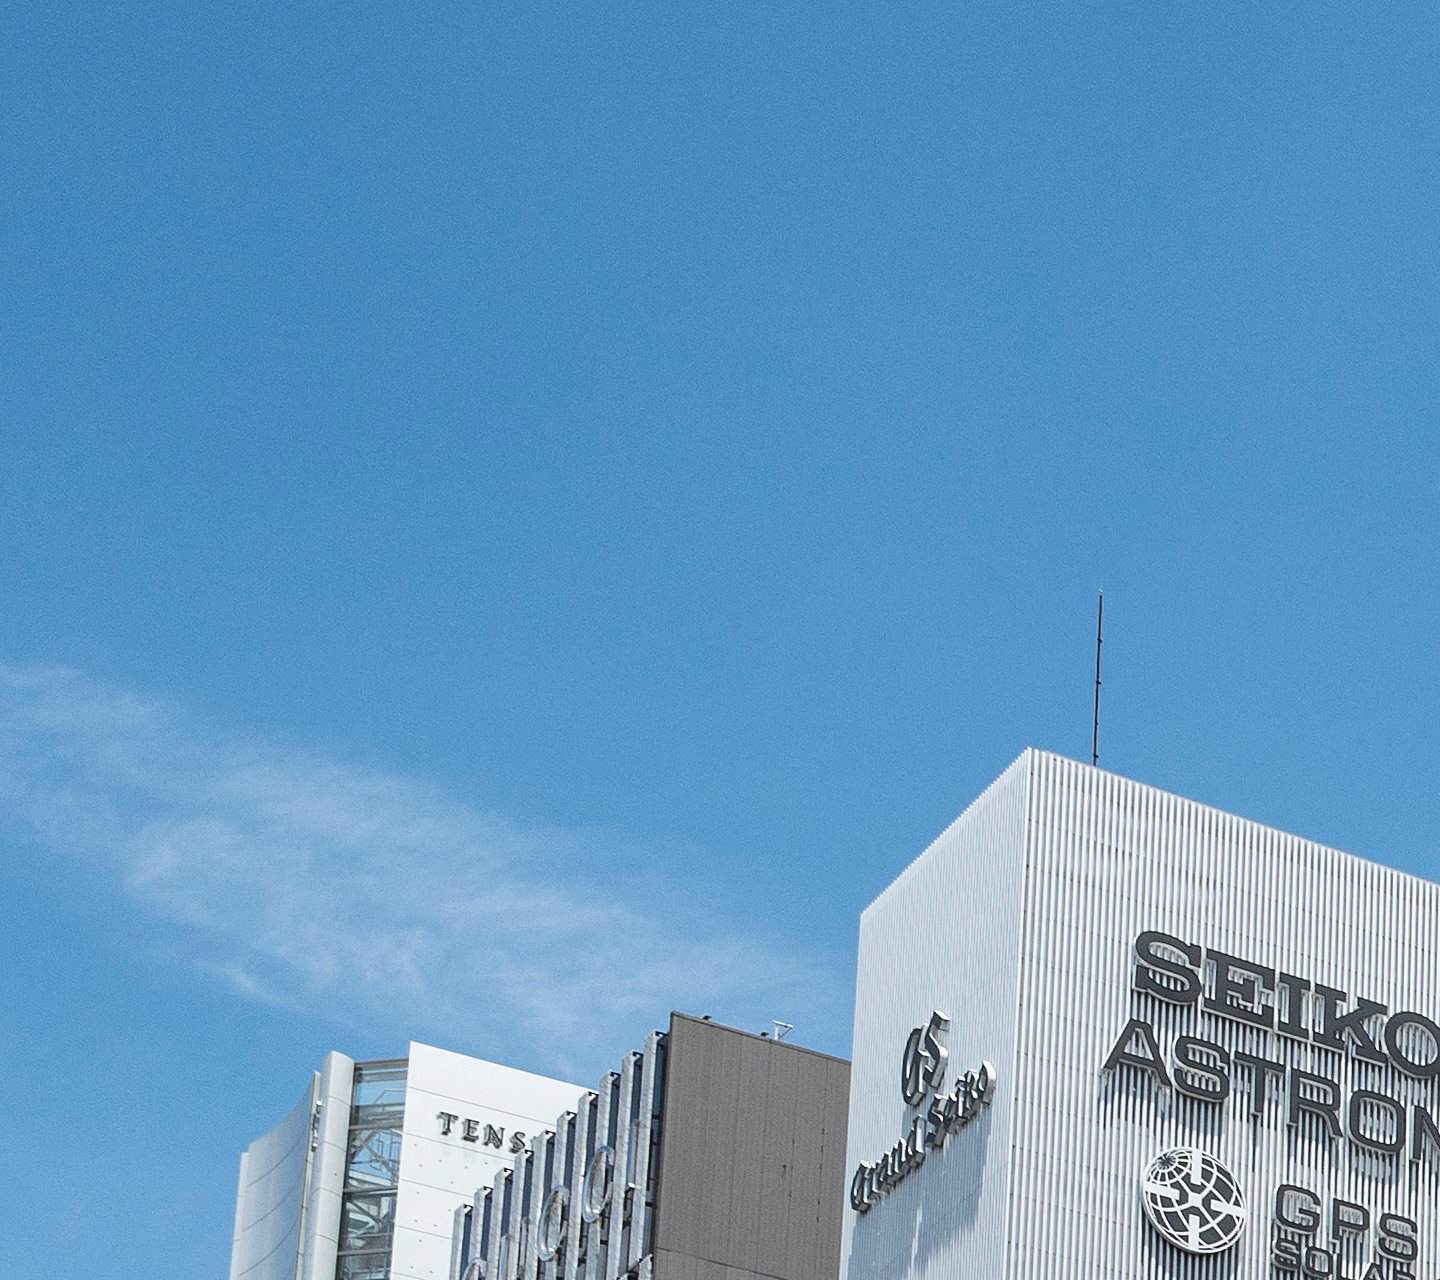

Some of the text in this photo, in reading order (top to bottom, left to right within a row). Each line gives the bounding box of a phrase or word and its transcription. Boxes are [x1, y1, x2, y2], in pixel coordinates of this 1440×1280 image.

[435, 1112, 528, 1154] TENS
[851, 1060, 998, 1213] Grand Seiko
[1275, 1183, 1419, 1263] GPS
